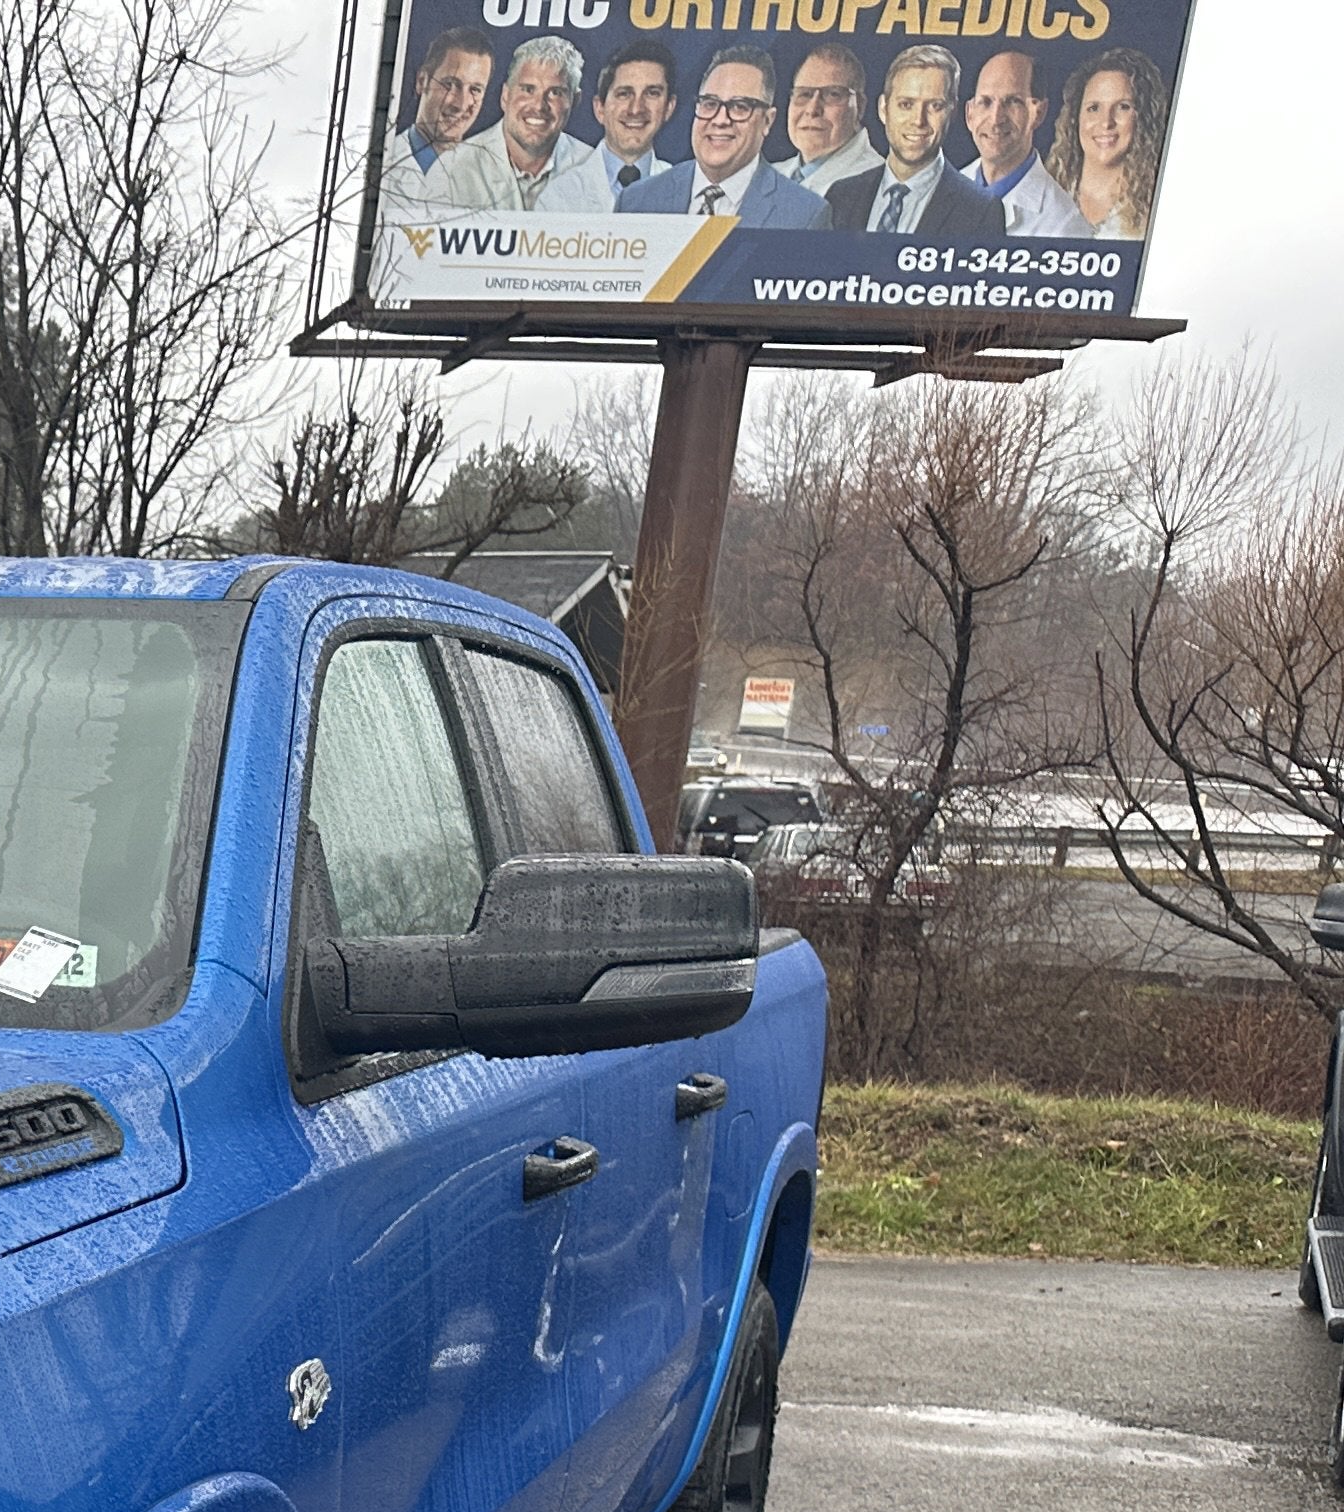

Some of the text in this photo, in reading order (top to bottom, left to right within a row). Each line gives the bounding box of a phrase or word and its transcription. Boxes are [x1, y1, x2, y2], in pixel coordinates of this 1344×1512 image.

[438, 227, 648, 260] WVUMedicine
[897, 246, 1121, 278] 681-342-3500
[485, 276, 642, 293] UNITED HOSPITAL CENTER
[753, 274, 1114, 311] wvorthocenter.com
